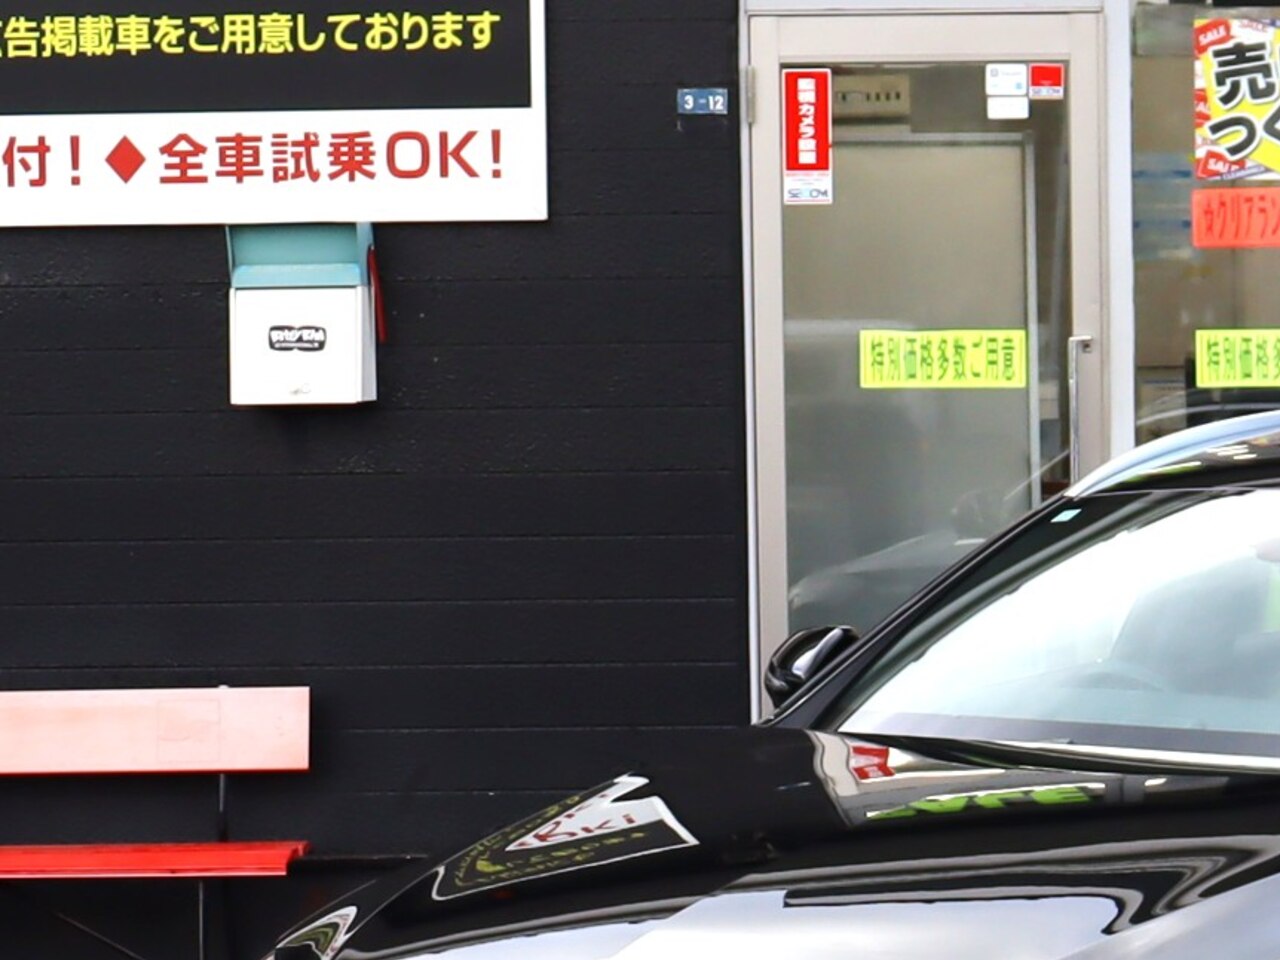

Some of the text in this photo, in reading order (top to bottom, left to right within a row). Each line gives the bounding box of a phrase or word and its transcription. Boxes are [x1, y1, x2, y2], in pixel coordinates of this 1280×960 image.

[0, 11, 501, 58] 告掲載車をご用意しております
[1198, 25, 1227, 44] SALE
[684, 95, 724, 110] 3-12
